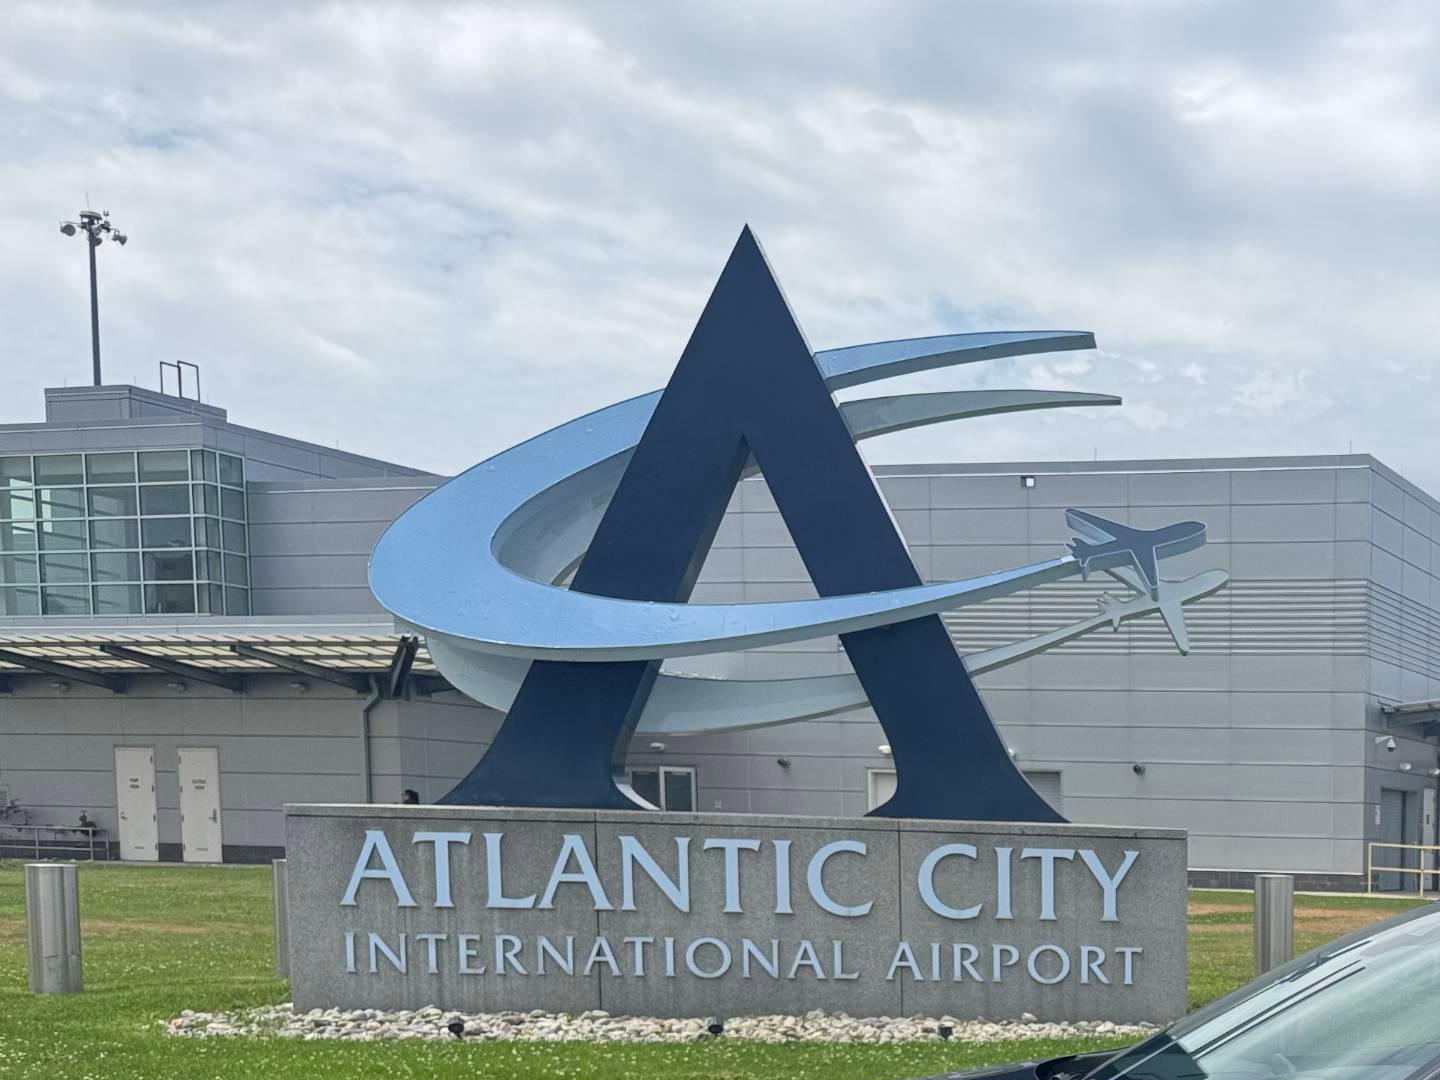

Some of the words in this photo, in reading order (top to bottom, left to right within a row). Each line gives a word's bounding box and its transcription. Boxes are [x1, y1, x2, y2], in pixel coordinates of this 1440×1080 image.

[341, 830, 874, 917] ATLANTIC
[918, 843, 1140, 921] CITY
[344, 932, 859, 980] INTERNATIONAL
[886, 942, 1143, 985] AIRPORT
